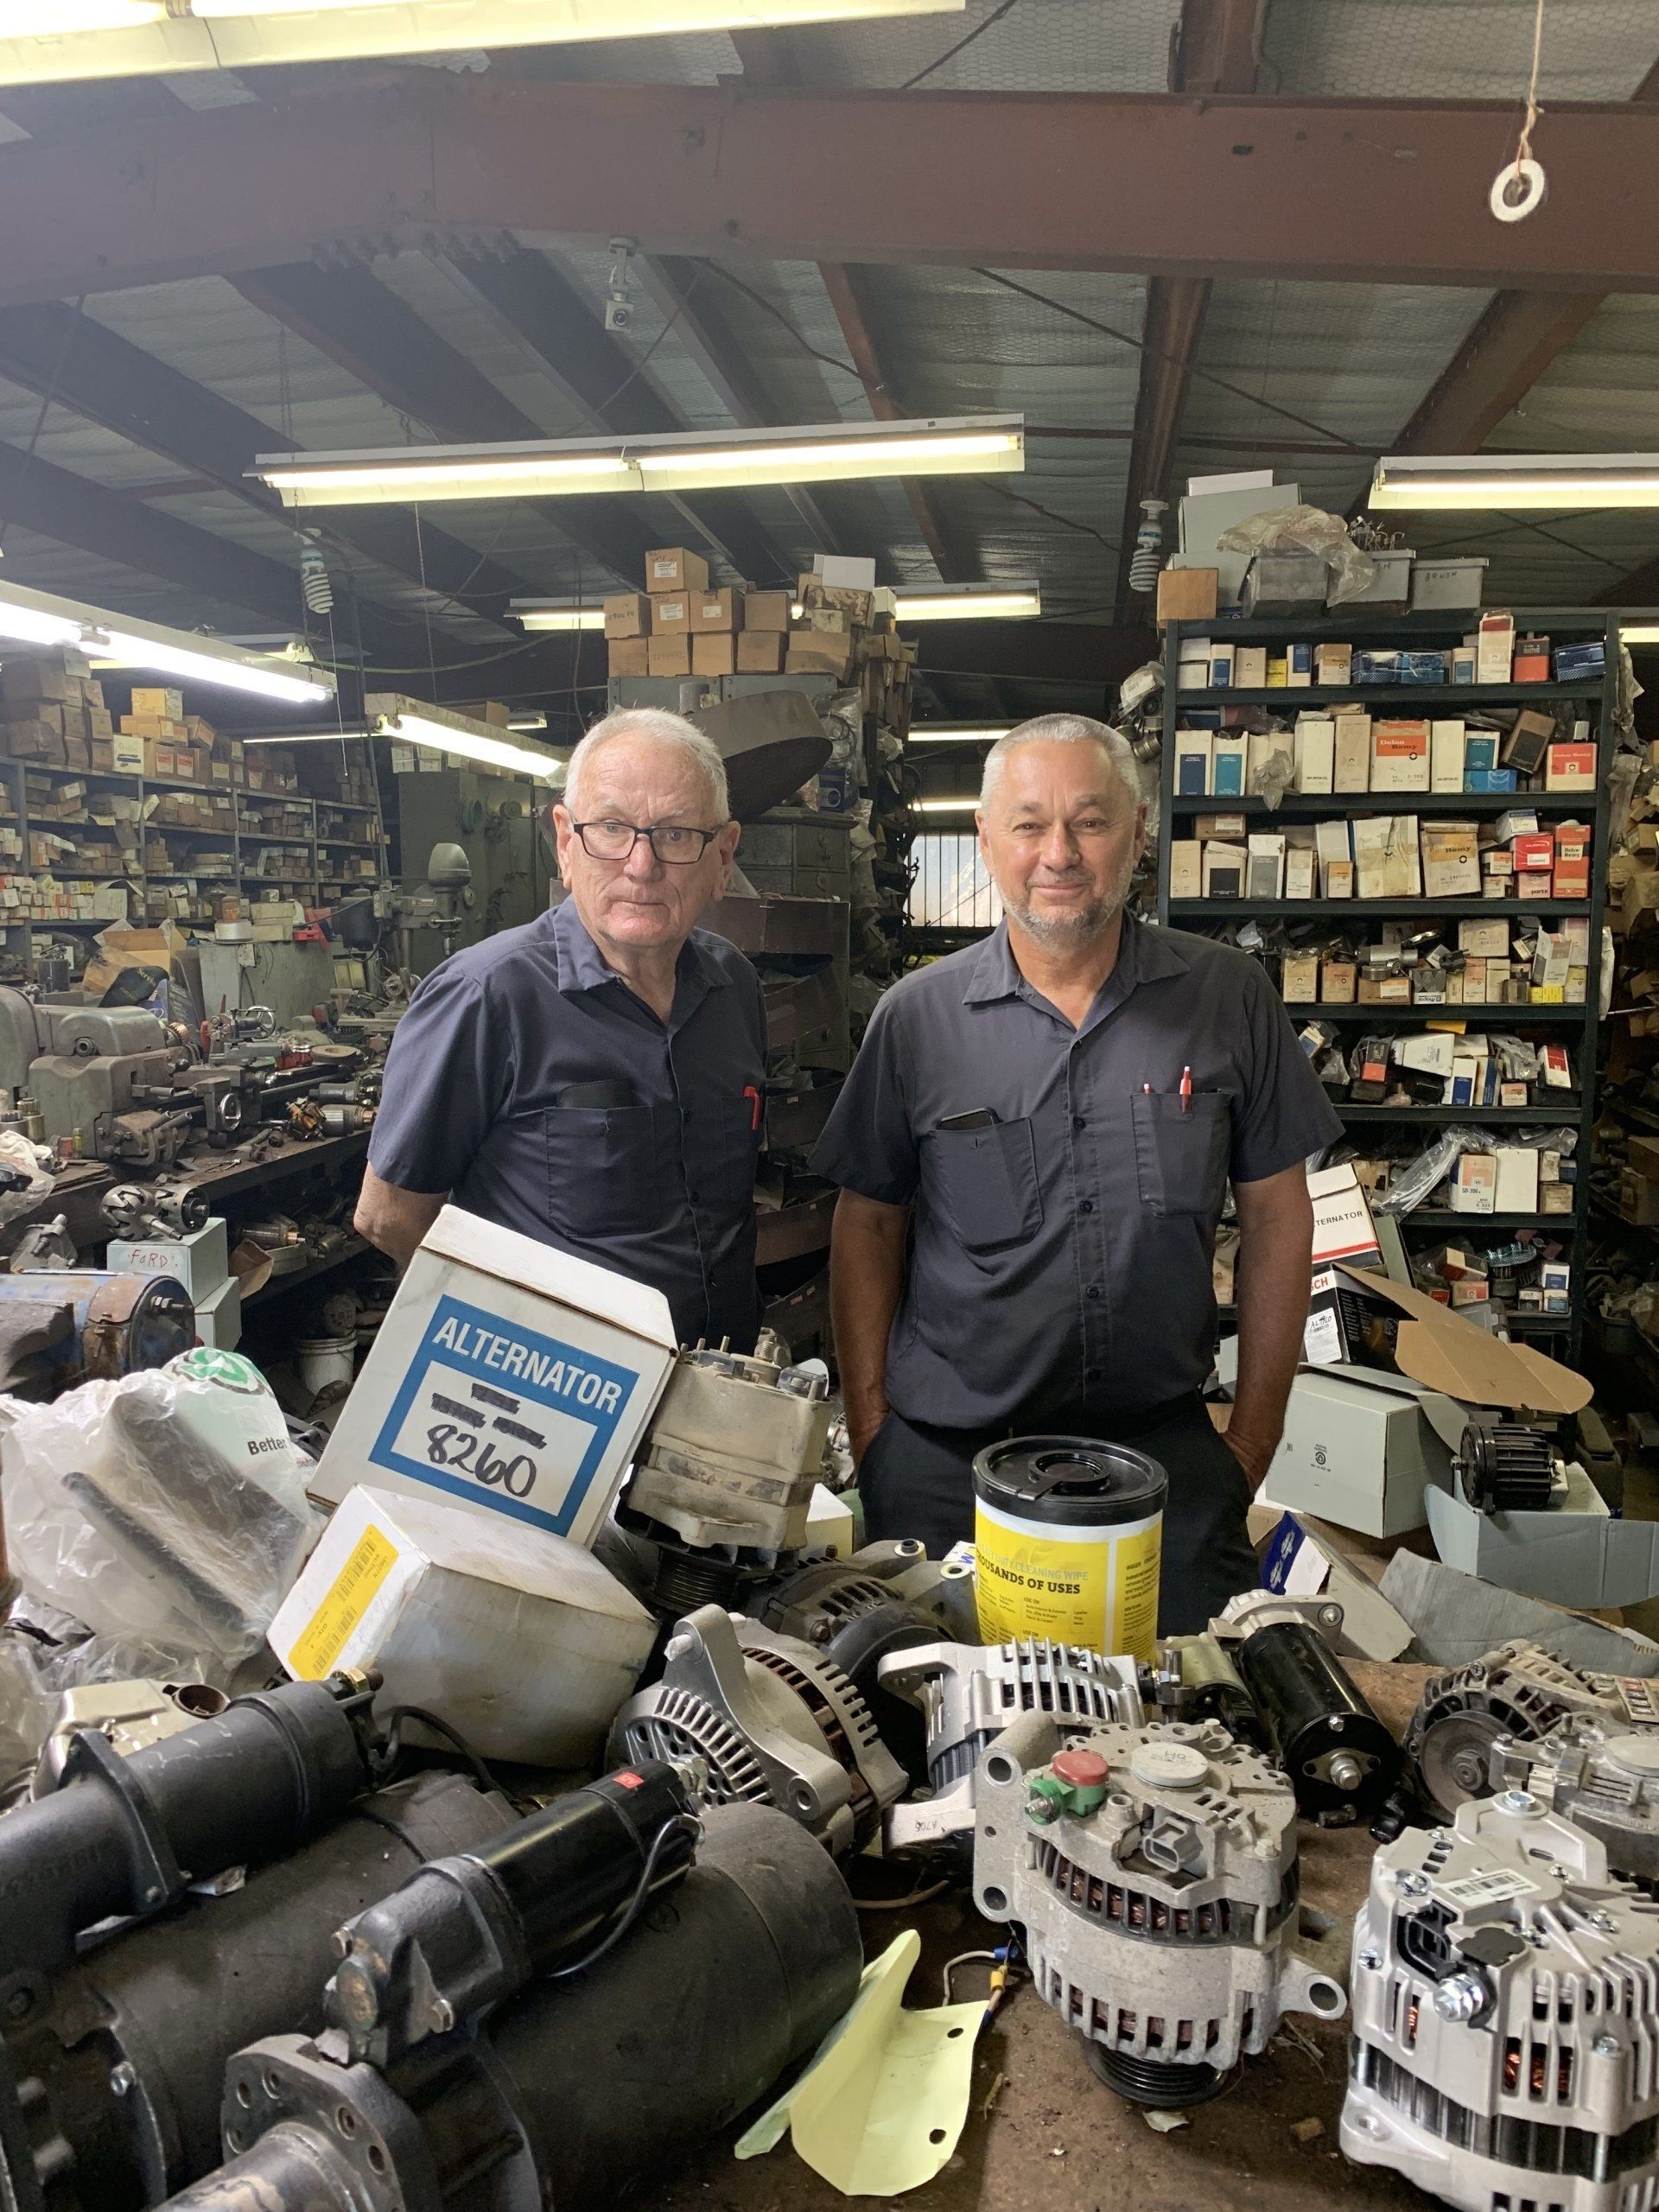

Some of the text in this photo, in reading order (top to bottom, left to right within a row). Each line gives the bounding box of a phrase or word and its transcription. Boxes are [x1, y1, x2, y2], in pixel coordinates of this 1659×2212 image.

[1315, 1211, 1363, 1227] TERNATOR
[1311, 1277, 1328, 1293] SCH
[432, 1316, 623, 1414] ALTERNATOR
[247, 1437, 287, 1456] Better
[427, 1424, 537, 1498] 8260
[1015, 1565, 1061, 1580] CLEANING
[1064, 1571, 1089, 1580] WIPE
[1027, 1578, 1044, 1590] OF
[1047, 1582, 1081, 1594] USES
